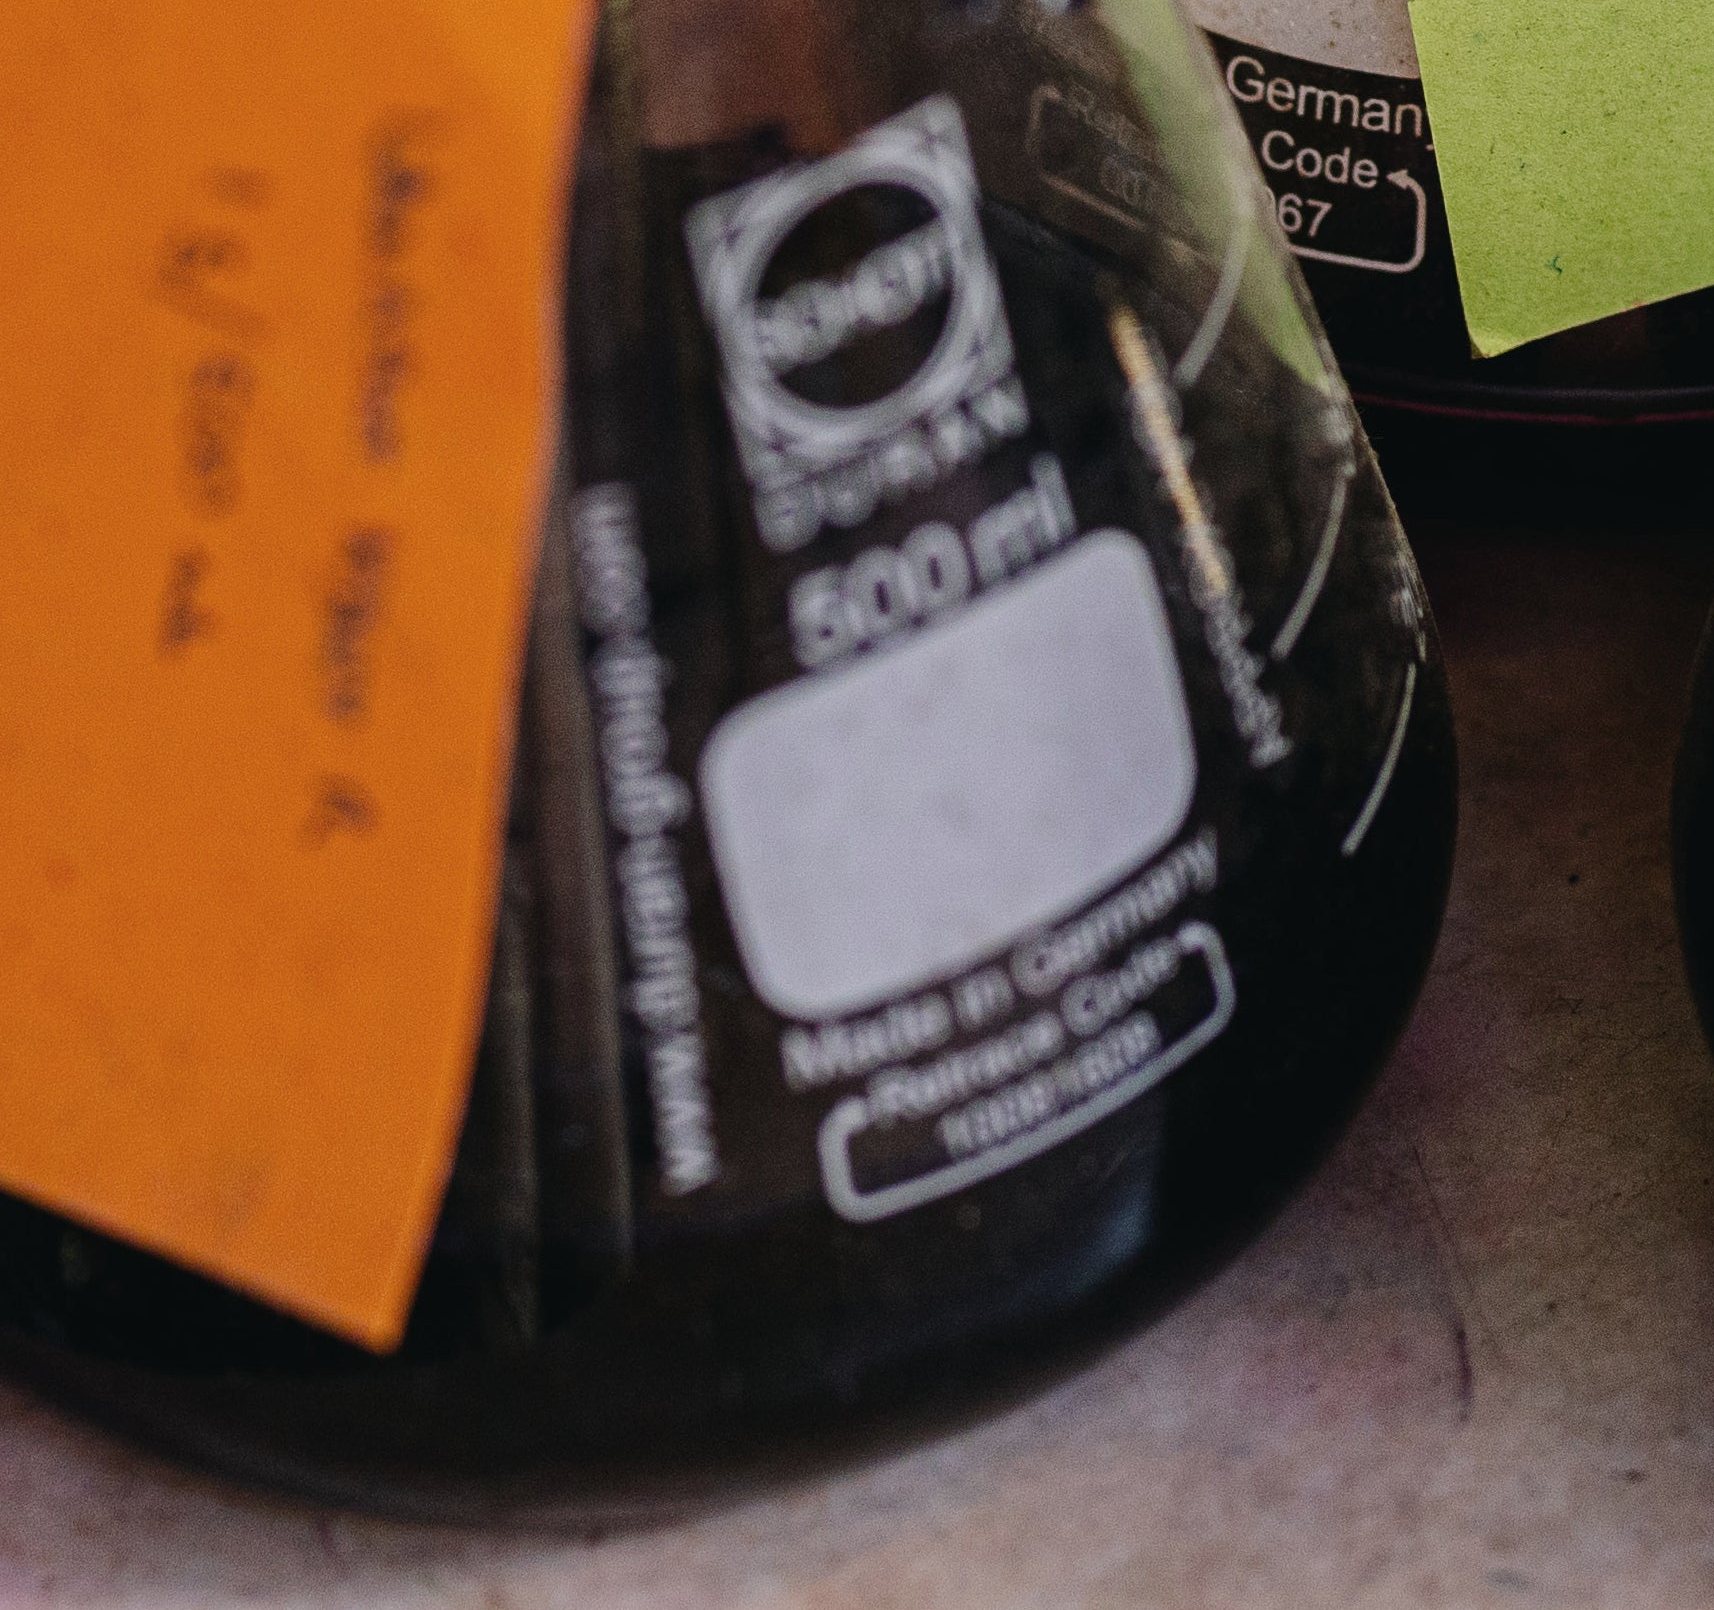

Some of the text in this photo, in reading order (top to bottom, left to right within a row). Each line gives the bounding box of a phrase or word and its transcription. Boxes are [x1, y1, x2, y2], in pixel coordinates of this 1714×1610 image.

[1227, 55, 1434, 150] German
[1261, 130, 1379, 188] Code
[789, 524, 969, 666] 500
